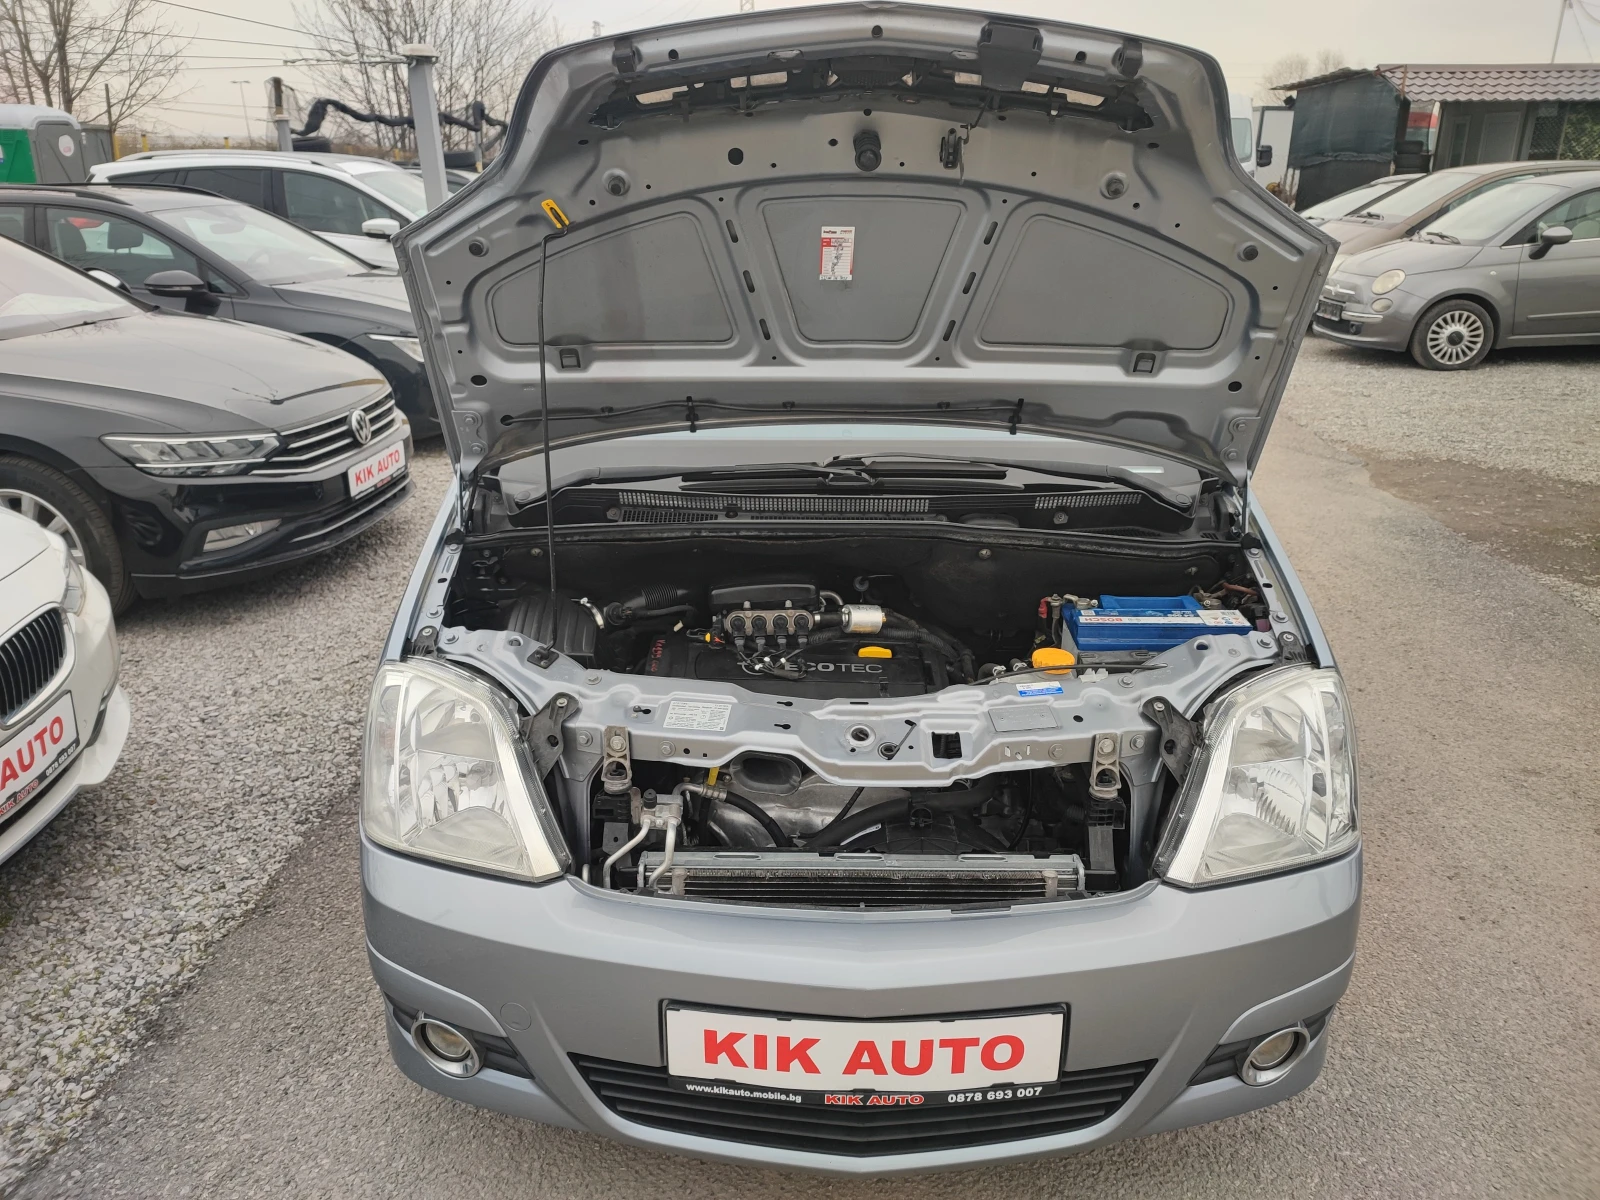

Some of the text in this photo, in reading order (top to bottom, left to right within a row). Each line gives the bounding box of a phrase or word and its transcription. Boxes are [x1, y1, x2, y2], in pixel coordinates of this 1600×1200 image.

[355, 464, 374, 487] KIK
[377, 450, 400, 475] AUTO
[0, 716, 64, 791] AUTO
[16, 779, 39, 804] AUTO
[703, 1029, 1025, 1076] KIK AUTO
[686, 1082, 802, 1103] www.kikauto.mobile.bg
[824, 1094, 925, 1105] KIK AUTO
[947, 1086, 1043, 1103] 0878 693 007
